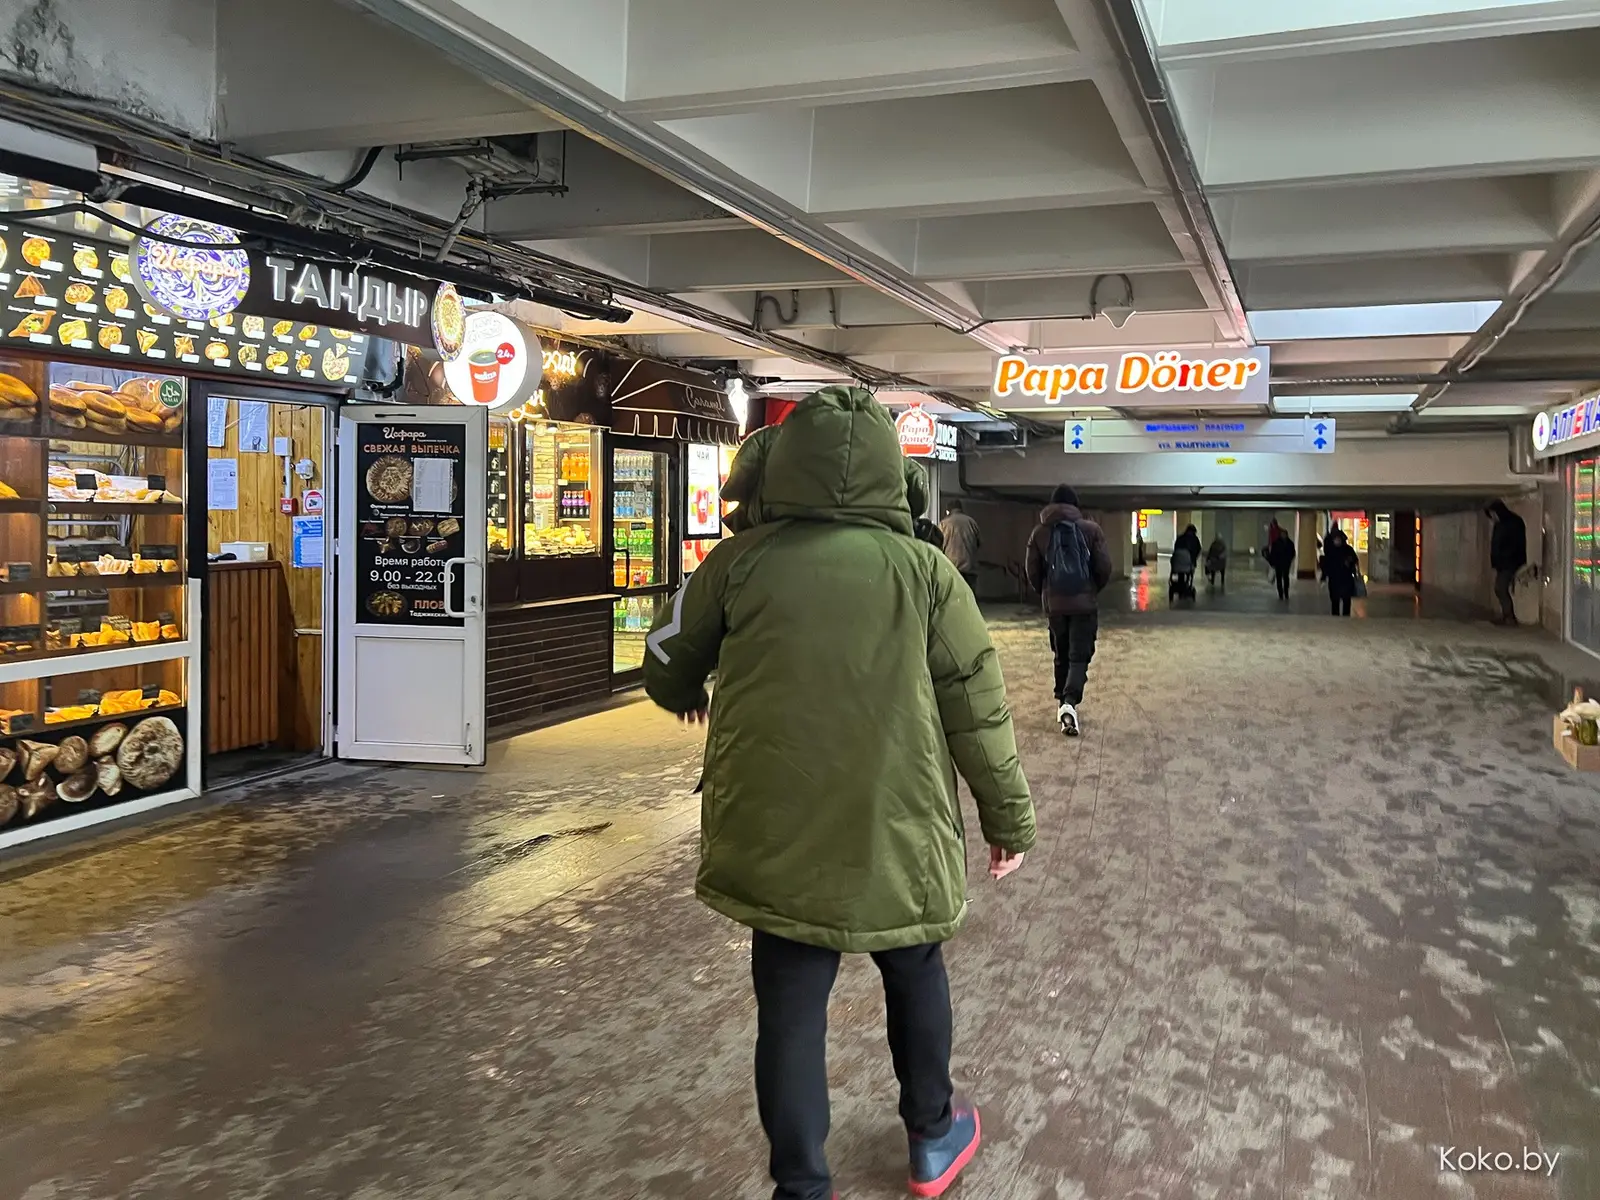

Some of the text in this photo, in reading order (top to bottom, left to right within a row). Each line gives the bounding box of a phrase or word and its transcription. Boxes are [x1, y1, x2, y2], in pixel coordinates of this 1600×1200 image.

[151, 243, 239, 281] Исфара
[265, 255, 428, 328] ТАНДЫР
[996, 353, 1258, 402] Papa Döner
[382, 427, 426, 441] Исфара
[901, 424, 929, 434] Papa
[363, 444, 460, 454] СВЕЖАЯ ВЫПЕЧКА
[375, 556, 408, 567] Время
[370, 570, 401, 582] 9.00
[386, 582, 400, 590] без
[414, 600, 444, 609] ПЛОВ
